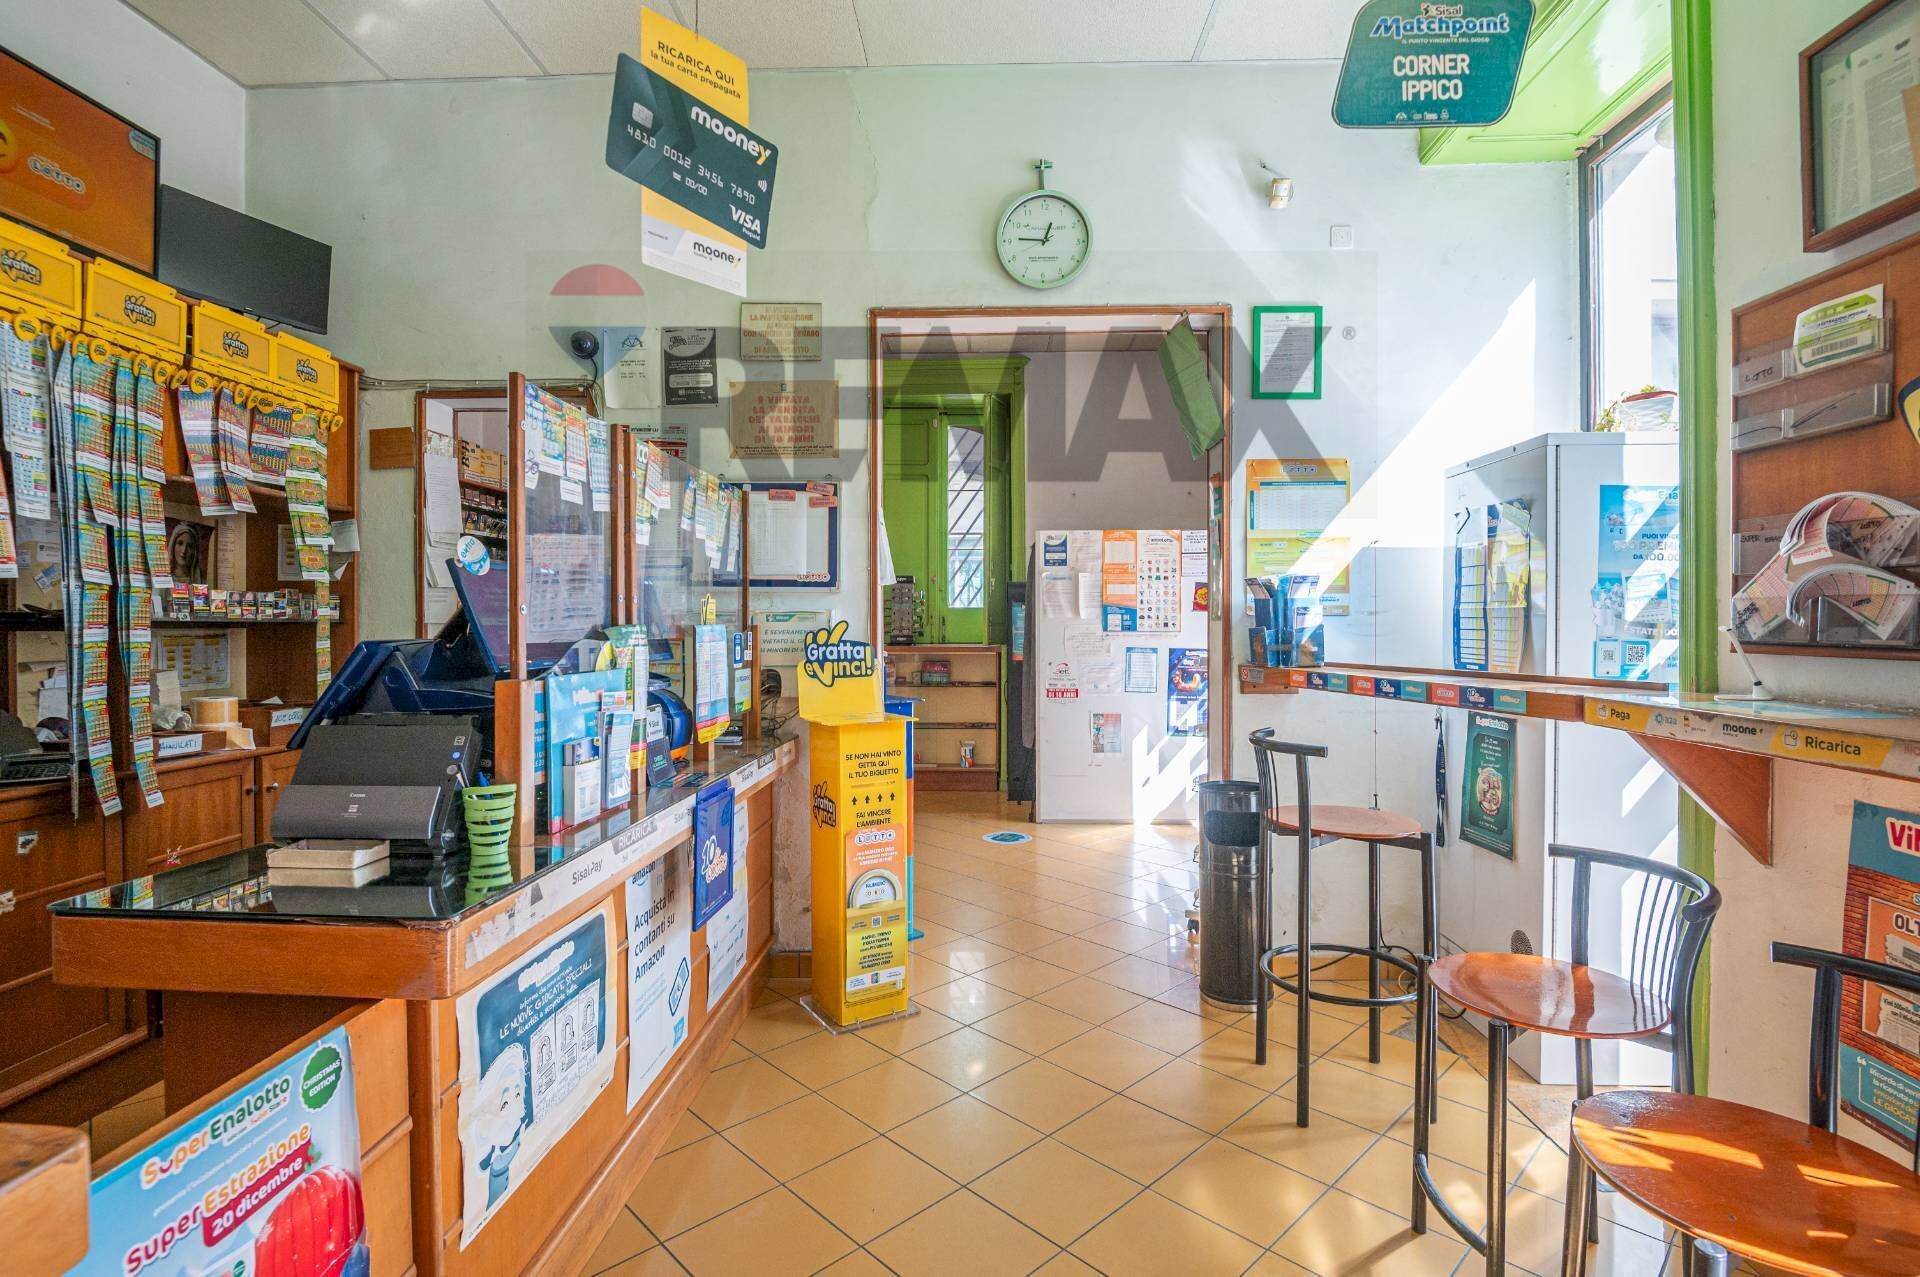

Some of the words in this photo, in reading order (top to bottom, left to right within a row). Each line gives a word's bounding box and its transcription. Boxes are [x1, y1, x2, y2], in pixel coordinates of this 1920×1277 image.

[1434, 3, 1462, 16] Sisal
[1370, 13, 1510, 40] Matchpoint
[650, 50, 658, 60] la
[661, 56, 674, 67] tua
[677, 65, 698, 80] carta
[700, 74, 741, 100] prepagata
[658, 40, 712, 76] RICARICA
[715, 68, 735, 86] QUI
[1392, 54, 1470, 77] CORNER
[1402, 79, 1462, 102] IPPICO
[690, 105, 772, 166] mooney
[28, 155, 86, 194] LOTTO
[664, 145, 692, 170] 0012
[698, 165, 724, 188] 3456
[730, 183, 755, 206] 7890
[729, 204, 761, 234] VISA
[125, 301, 152, 318] Gratta
[768, 406, 816, 414] VENDITA
[774, 425, 814, 433] MINORI
[787, 435, 815, 443] ANNI
[807, 643, 864, 661] Gratta
[806, 662, 813, 676] e
[813, 655, 874, 687] Vinci!
[1610, 709, 1630, 721] Paga
[883, 750, 902, 758] VINTO
[1804, 735, 1862, 757] Ricarica
[870, 768, 898, 776] BIGLIETTO
[856, 817, 891, 828] L'AMBIENTE
[868, 808, 892, 817] VINCERE
[572, 858, 602, 885] SisalPay
[632, 861, 656, 884] amazon
[634, 895, 667, 932] Acquista
[668, 889, 674, 902] in
[634, 919, 666, 956] contanti
[667, 912, 675, 928] su
[634, 944, 665, 984] Amazon
[500, 1024, 510, 1040] LE
[510, 1004, 534, 1028] NUOVE
[534, 982, 564, 1010] GIOCATE
[566, 958, 592, 985] SPECIALI
[302, 1060, 340, 1090] CHRISTMAS
[308, 1074, 336, 1096] EDITION
[142, 1077, 290, 1186] SuperEnalotto
[211, 1210, 233, 1237] 20
[236, 1156, 303, 1219] dicembre
